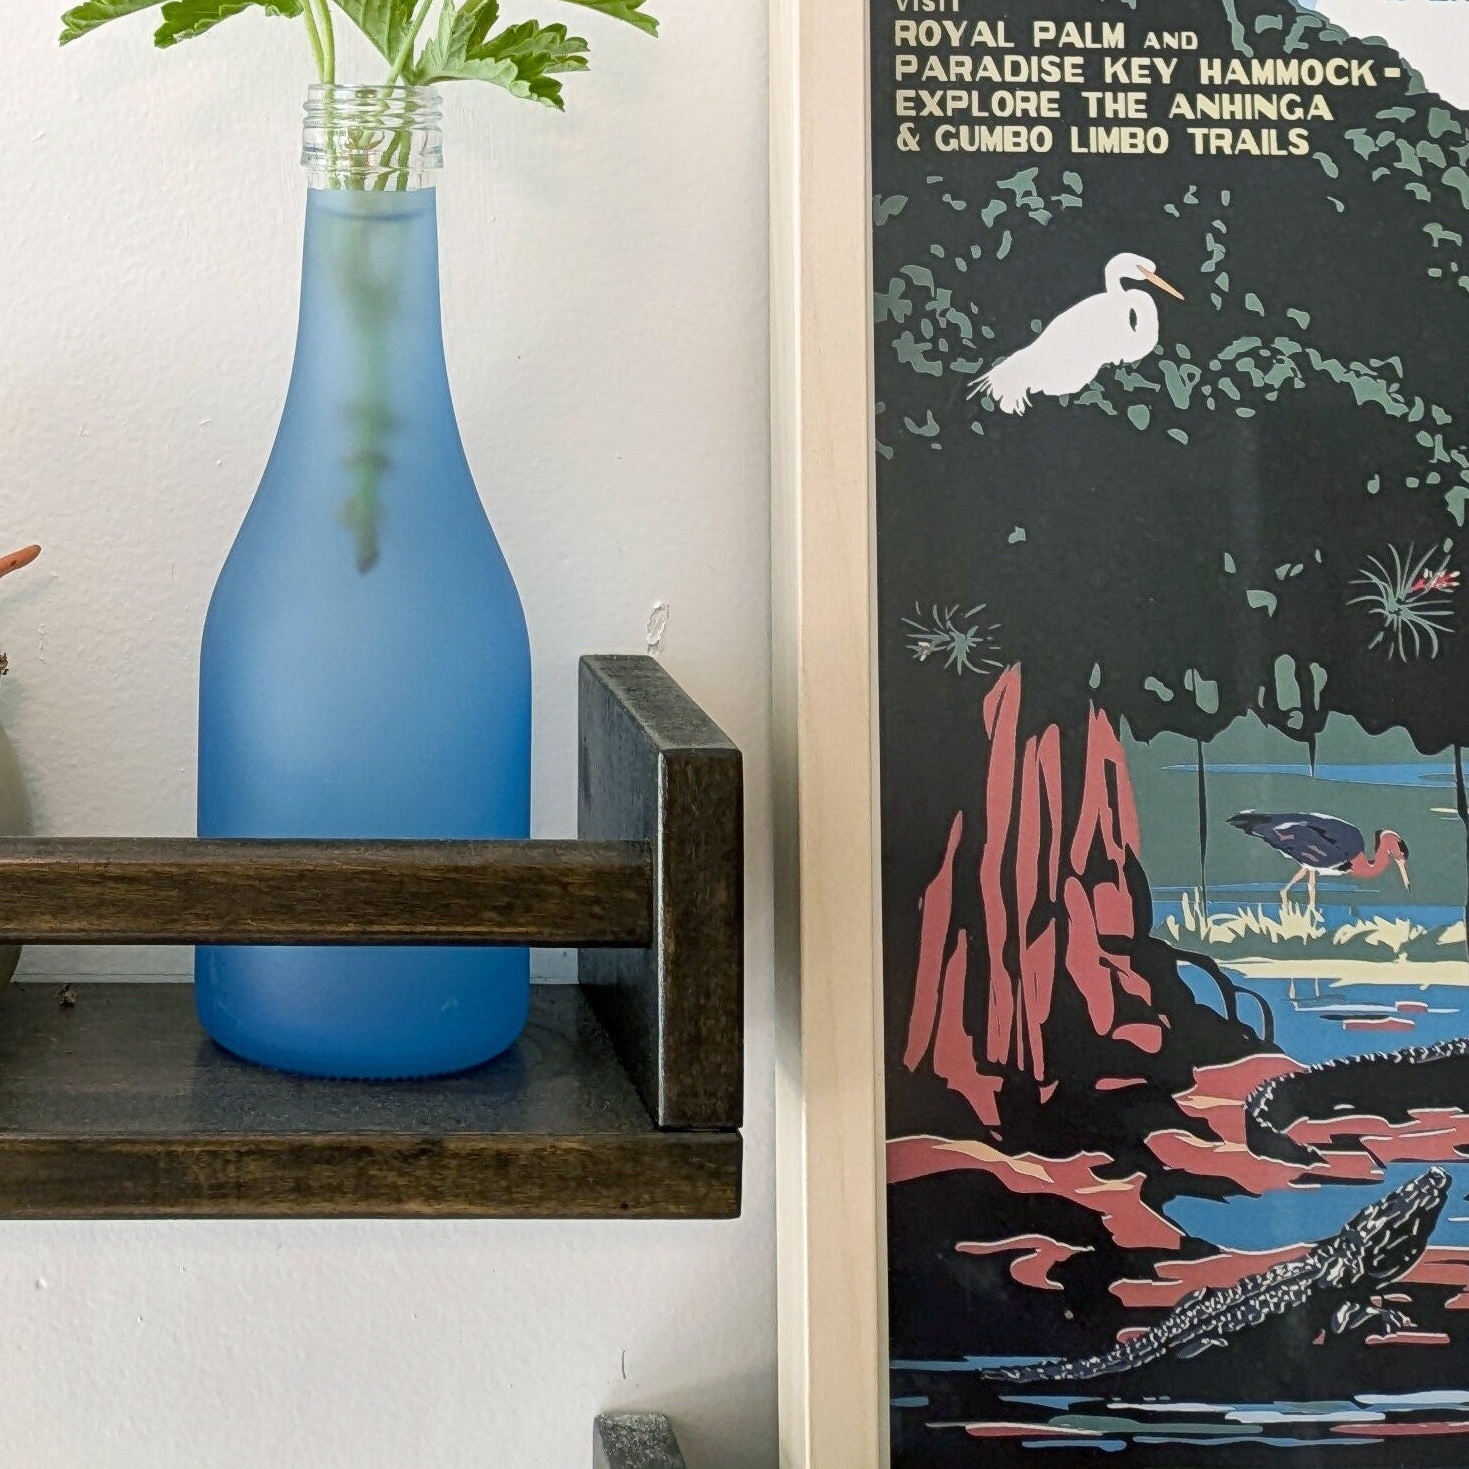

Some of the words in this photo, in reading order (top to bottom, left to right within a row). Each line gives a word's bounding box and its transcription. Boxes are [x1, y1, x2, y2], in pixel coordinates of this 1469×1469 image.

[894, 19, 1015, 48] ROYAL
[1033, 21, 1125, 49] PALM
[1143, 31, 1199, 50] AND
[895, 55, 1084, 84] PARADISE
[1104, 56, 1178, 85] KEY
[895, 89, 1060, 118] EXPLORE
[1081, 91, 1148, 119] THE
[1168, 92, 1334, 121] ANHINGA
[896, 122, 921, 152] &
[934, 124, 1053, 153] GUMBO
[1071, 126, 1169, 154] LIMBO
[1187, 127, 1310, 156] TRAILS
